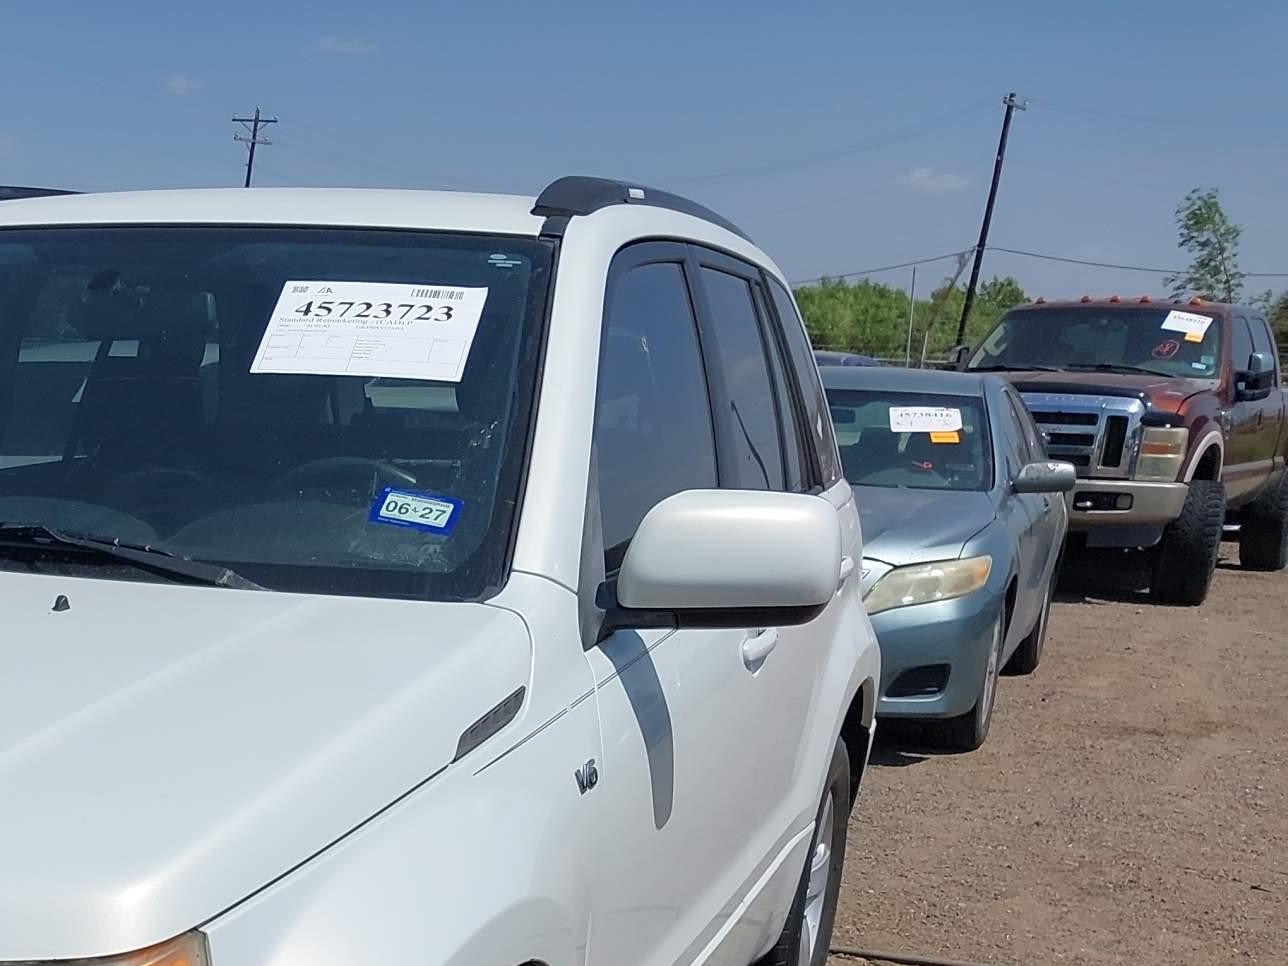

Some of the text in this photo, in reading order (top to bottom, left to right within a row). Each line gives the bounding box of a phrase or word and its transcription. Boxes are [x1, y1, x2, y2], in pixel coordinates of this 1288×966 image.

[294, 300, 454, 321] 45723723
[385, 500, 411, 515] 06
[419, 506, 447, 521] 27
[575, 758, 598, 795] V6
